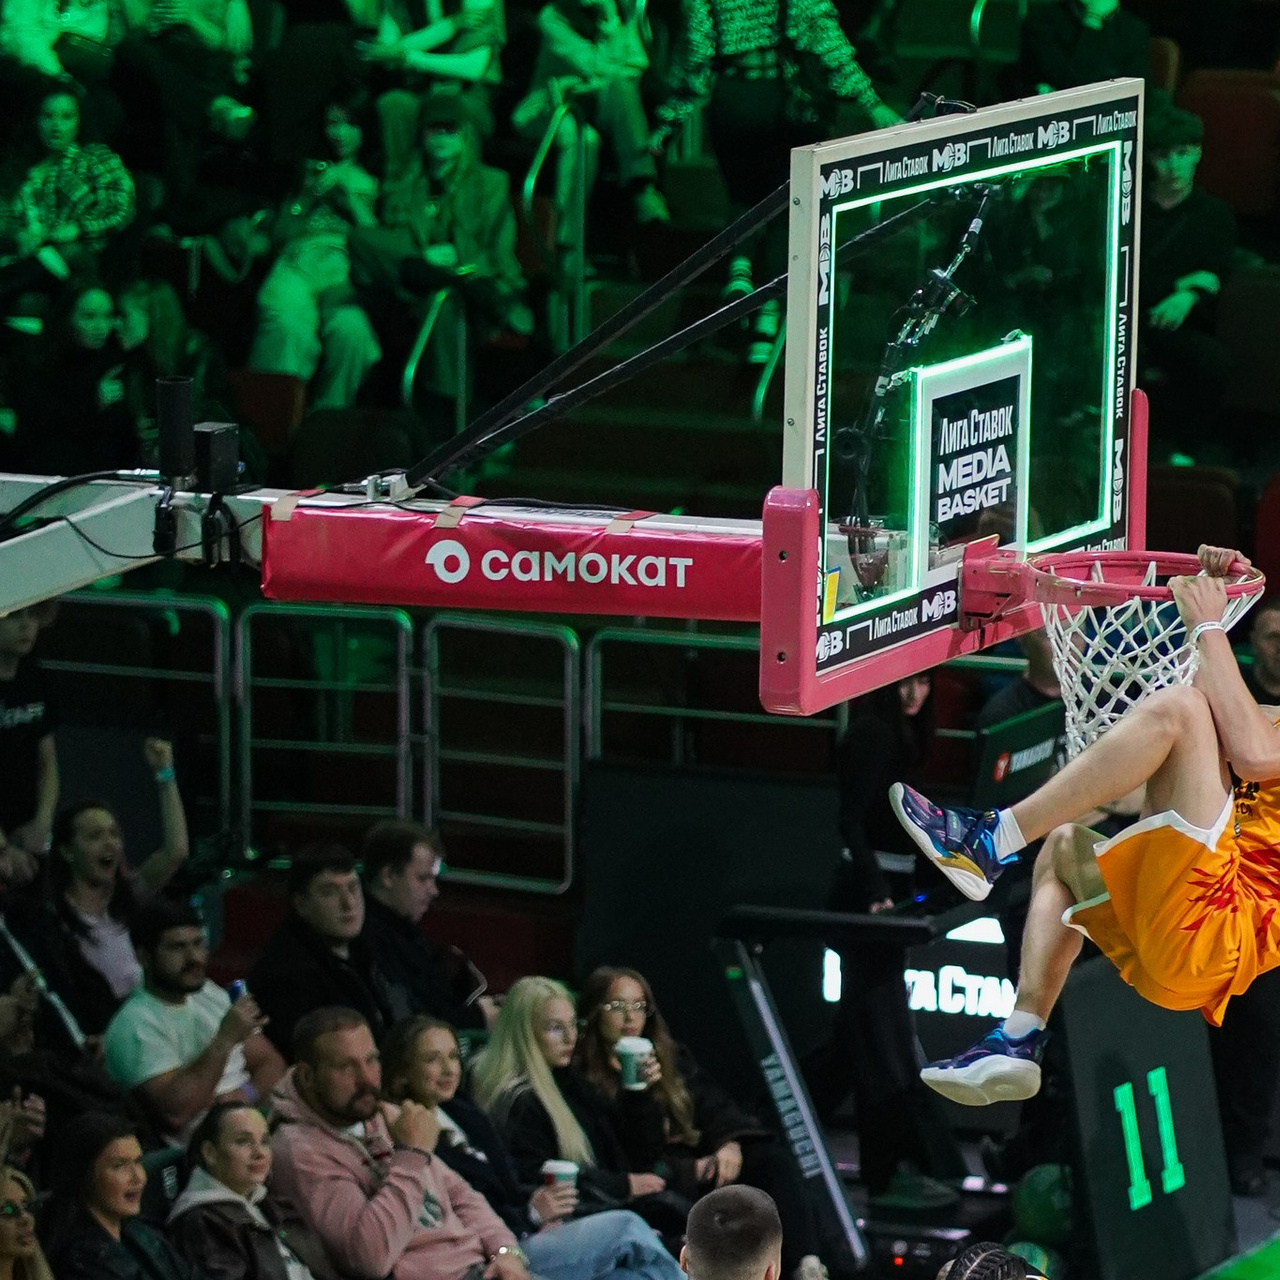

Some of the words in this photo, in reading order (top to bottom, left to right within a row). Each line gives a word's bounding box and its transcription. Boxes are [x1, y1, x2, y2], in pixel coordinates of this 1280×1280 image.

[937, 445, 1011, 495] MEDIA
[937, 477, 1011, 523] BASKET
[1113, 1065, 1186, 1211] 11
